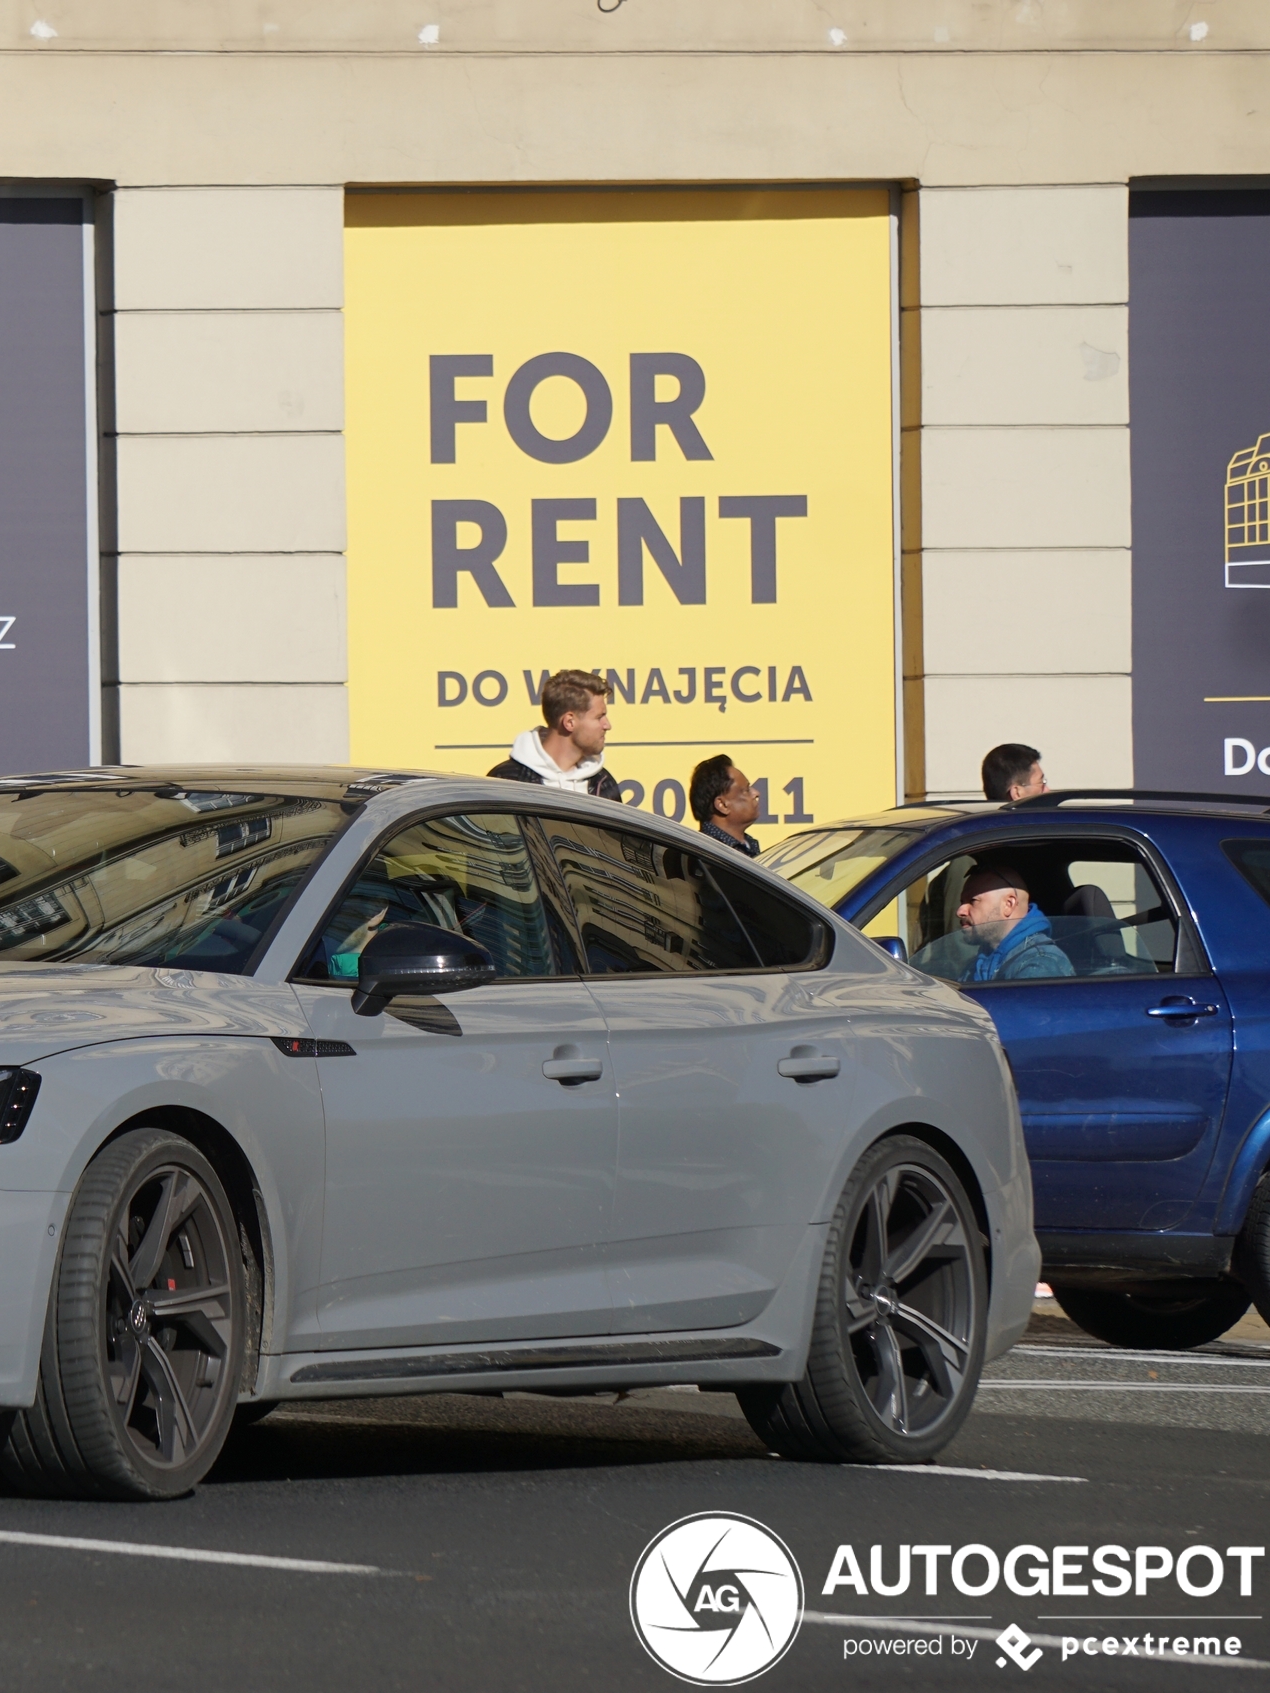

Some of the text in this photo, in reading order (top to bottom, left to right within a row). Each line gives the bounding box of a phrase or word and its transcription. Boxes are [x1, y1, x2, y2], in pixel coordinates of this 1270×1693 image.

[428, 351, 715, 465] FOR
[431, 495, 808, 609] RENT
[437, 666, 814, 713] DO NAJĘCIA
[618, 778, 687, 823] 20
